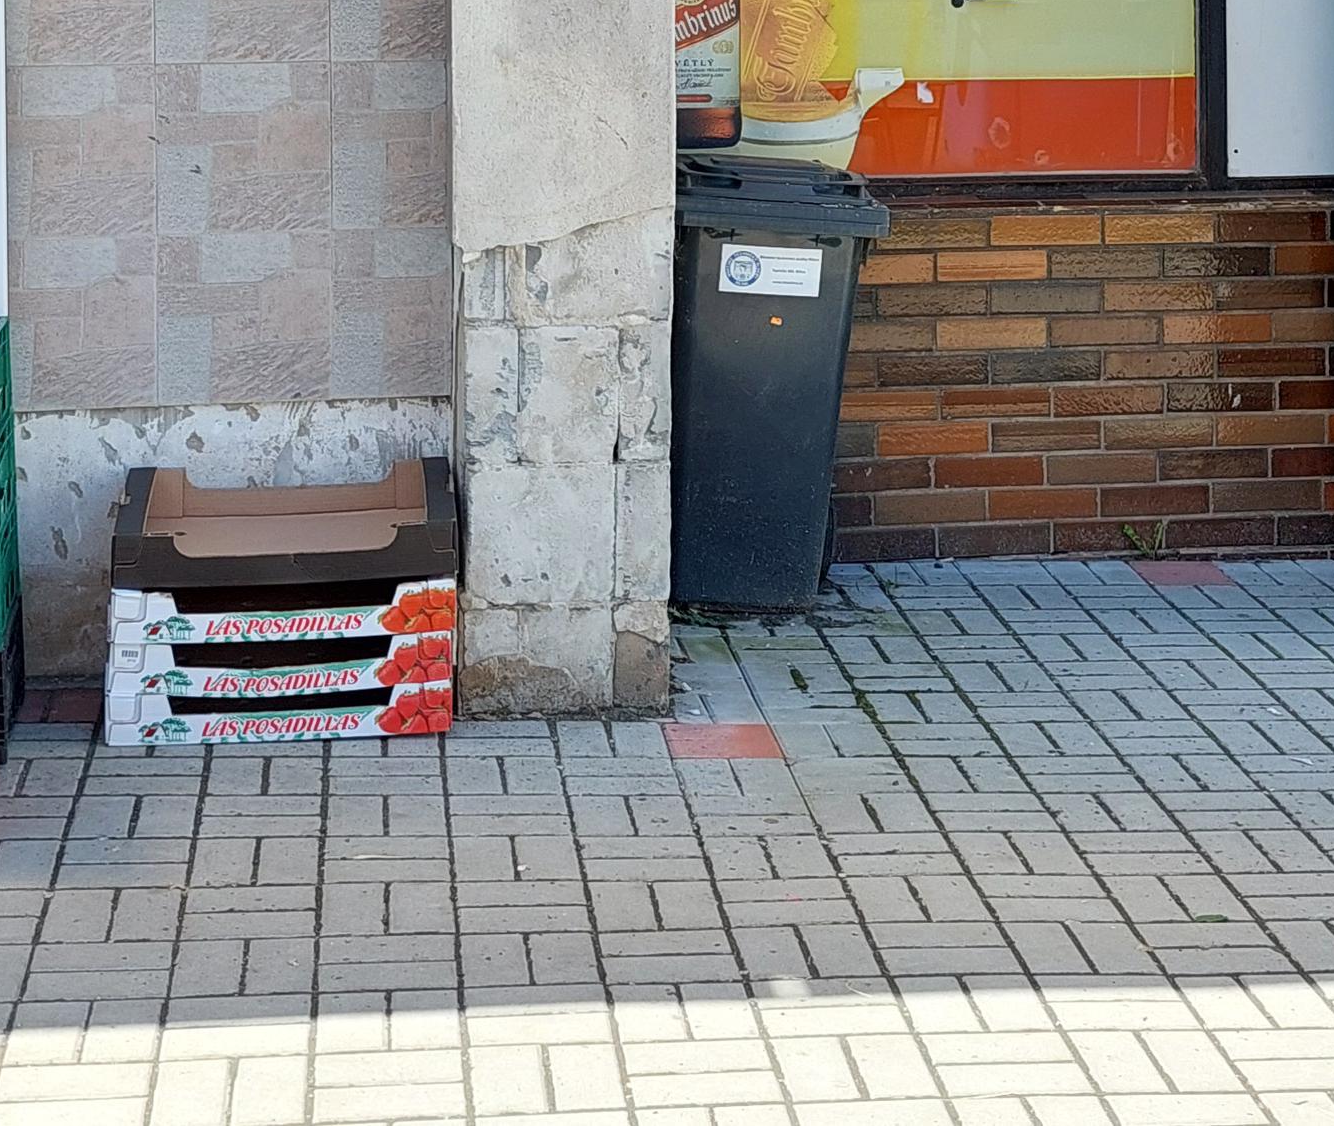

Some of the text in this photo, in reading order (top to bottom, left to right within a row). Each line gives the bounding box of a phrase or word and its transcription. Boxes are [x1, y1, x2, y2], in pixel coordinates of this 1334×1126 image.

[205, 614, 364, 636] LAS POSADILLAS
[203, 669, 360, 692] LAS POSADILLAS
[202, 714, 361, 737] LAS POSADILLAS
